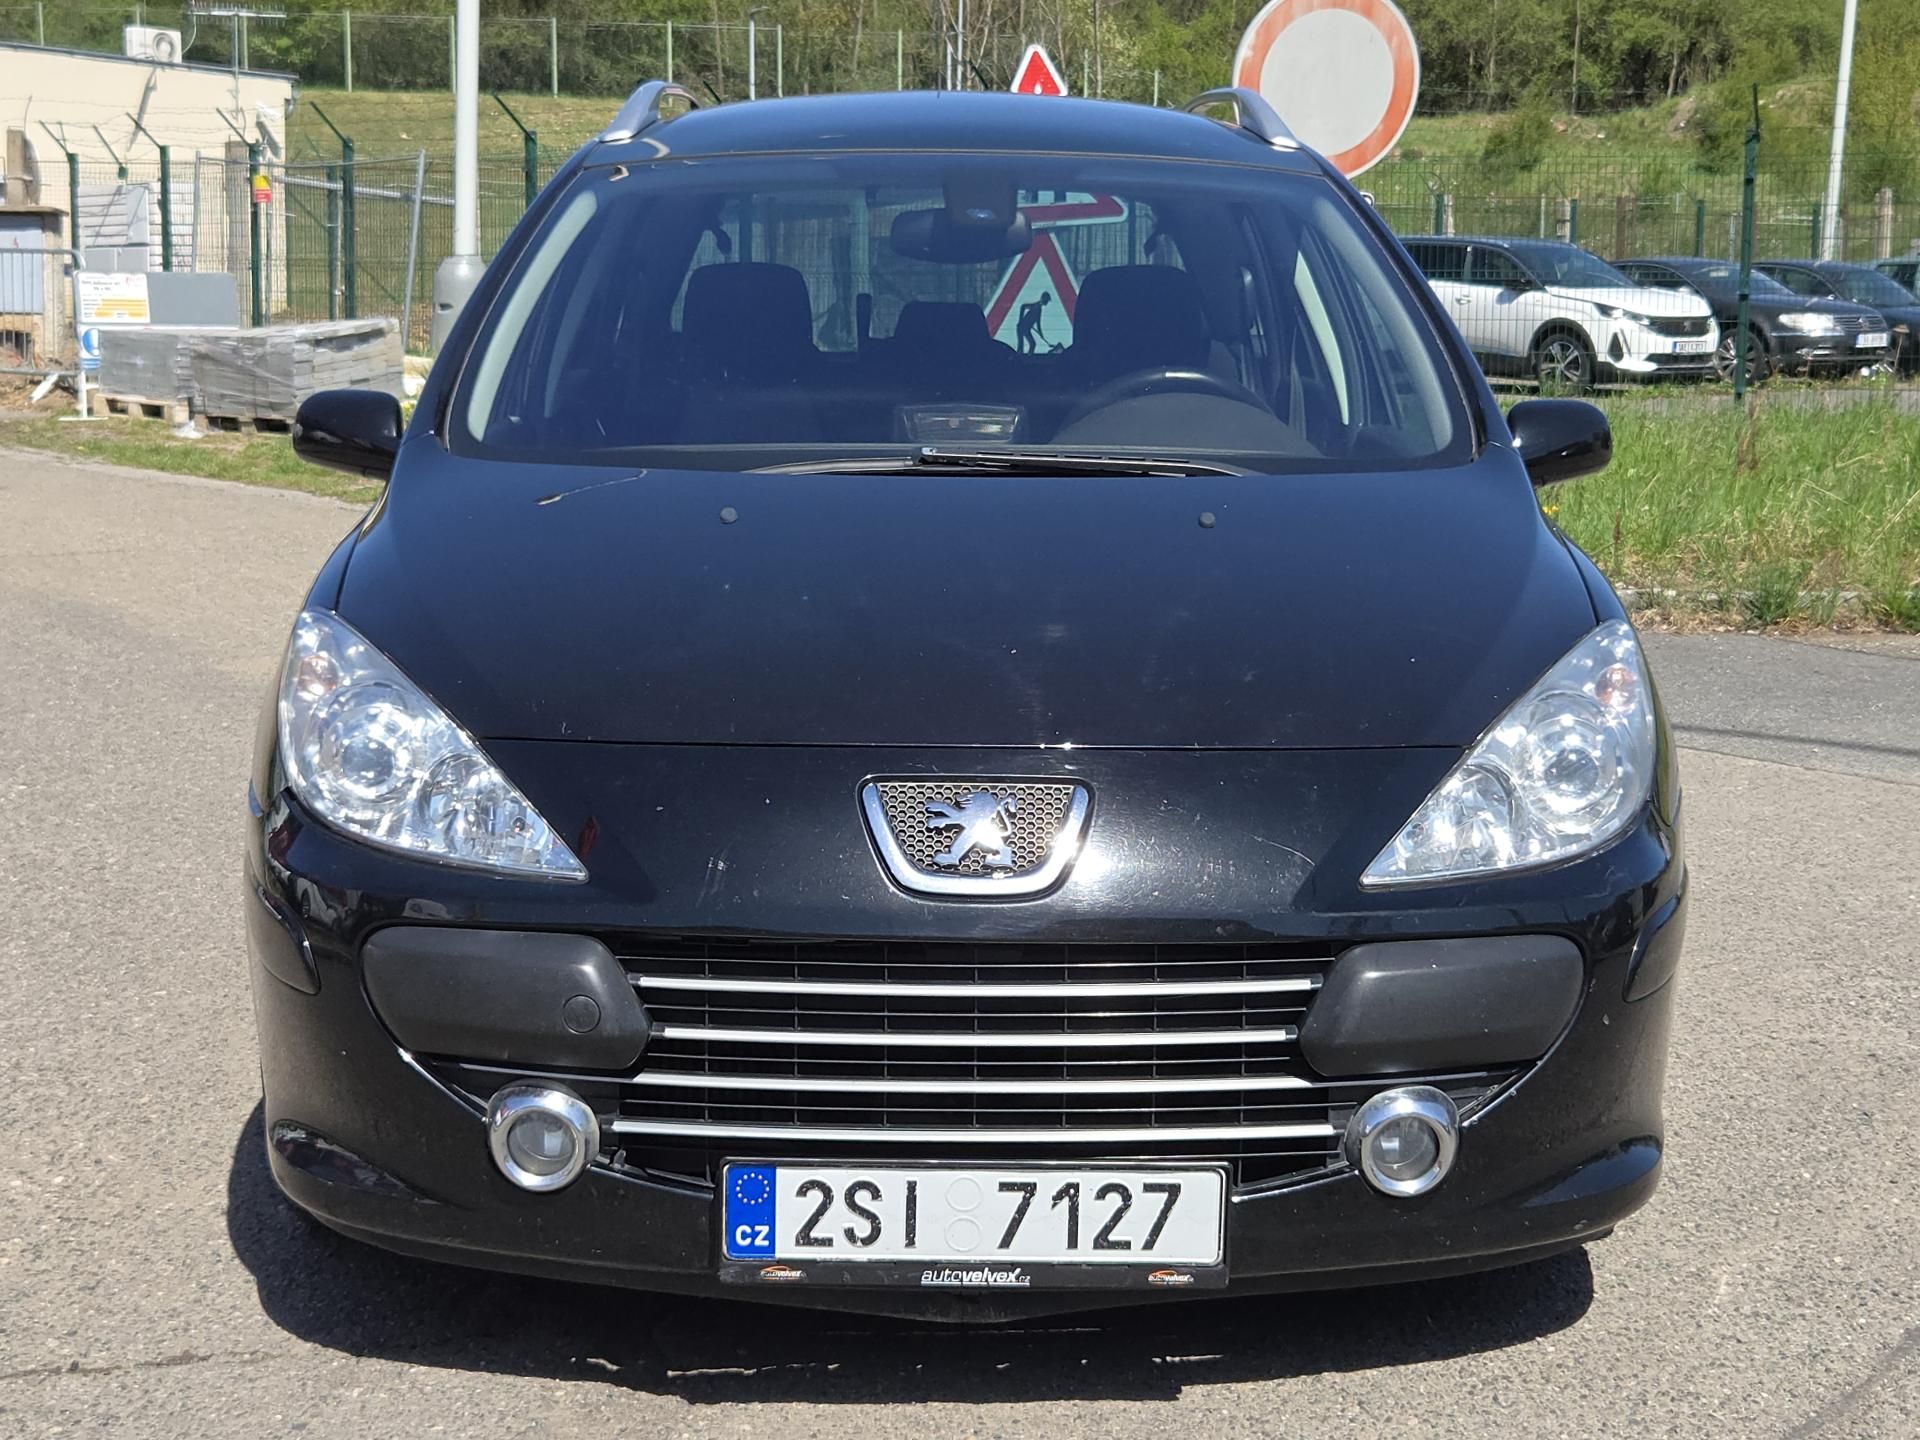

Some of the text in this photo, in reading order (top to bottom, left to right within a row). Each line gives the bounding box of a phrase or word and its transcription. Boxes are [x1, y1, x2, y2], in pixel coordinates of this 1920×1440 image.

[735, 1225, 770, 1247] CZ
[795, 1179, 1182, 1251] 2SI 7127
